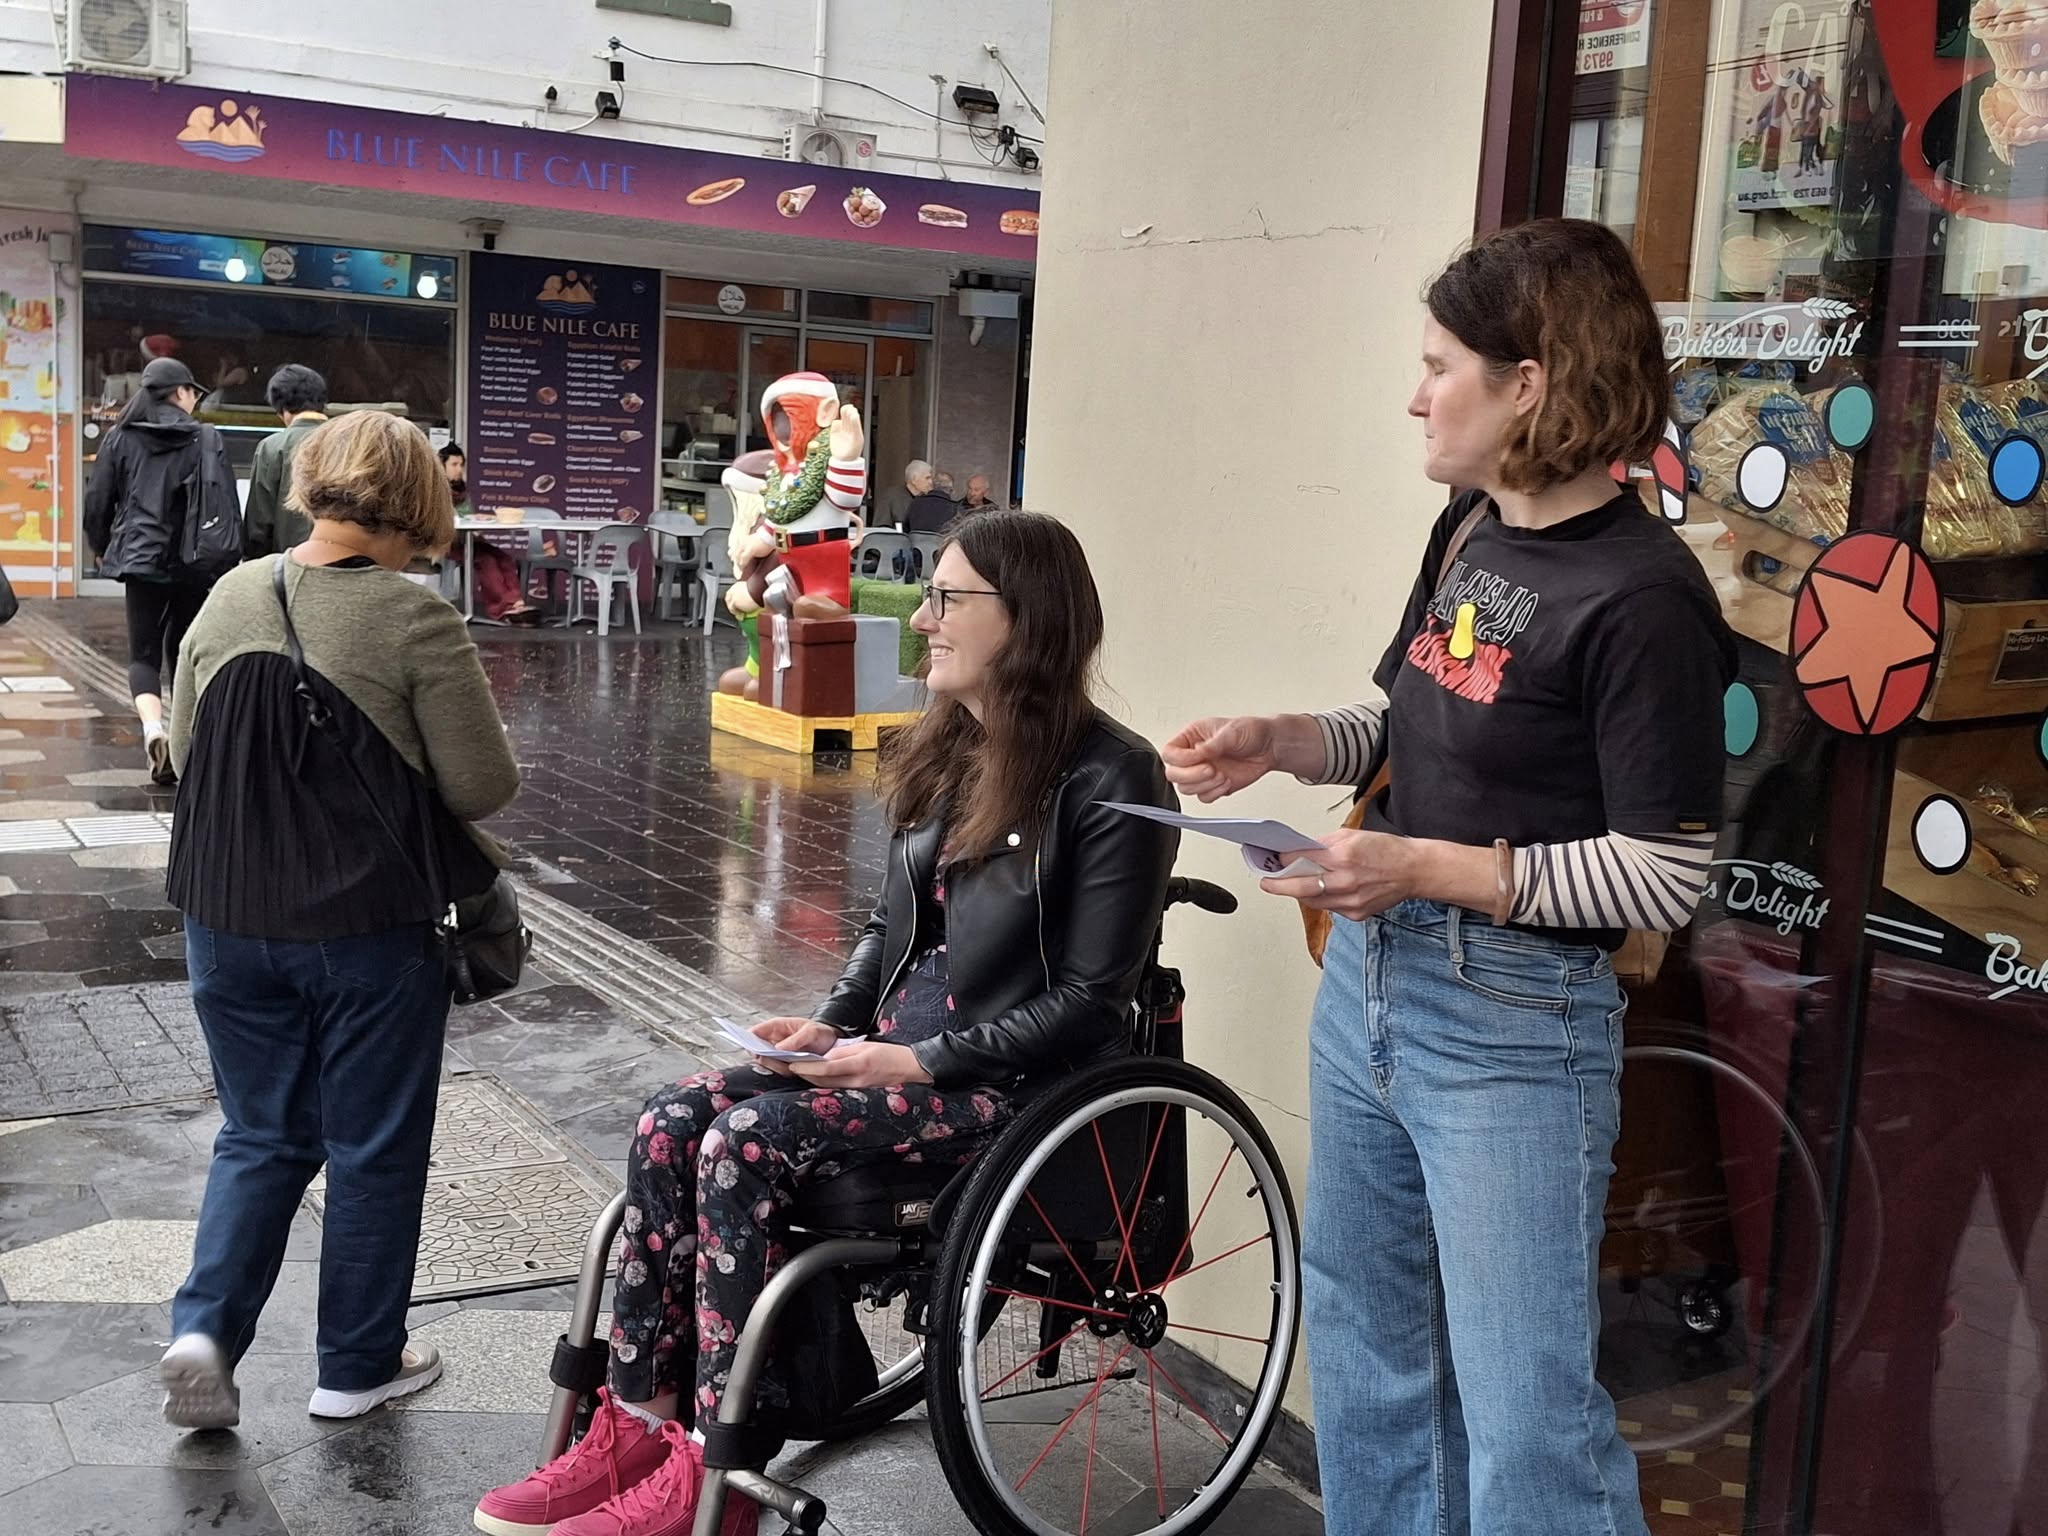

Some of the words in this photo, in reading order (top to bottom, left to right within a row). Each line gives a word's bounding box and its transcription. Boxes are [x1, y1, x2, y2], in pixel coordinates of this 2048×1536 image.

[326, 128, 424, 169] BLUE
[440, 144, 530, 182] NILE
[543, 155, 640, 195] CAFE
[0, 226, 34, 247] resh
[489, 312, 536, 332] BLUE
[543, 317, 588, 336] NILE
[592, 320, 641, 339] CAFE
[1661, 315, 1749, 360] Bakers
[1757, 314, 1865, 374] Delight
[1726, 866, 1832, 936] Delight
[901, 1204, 918, 1214] JAY
